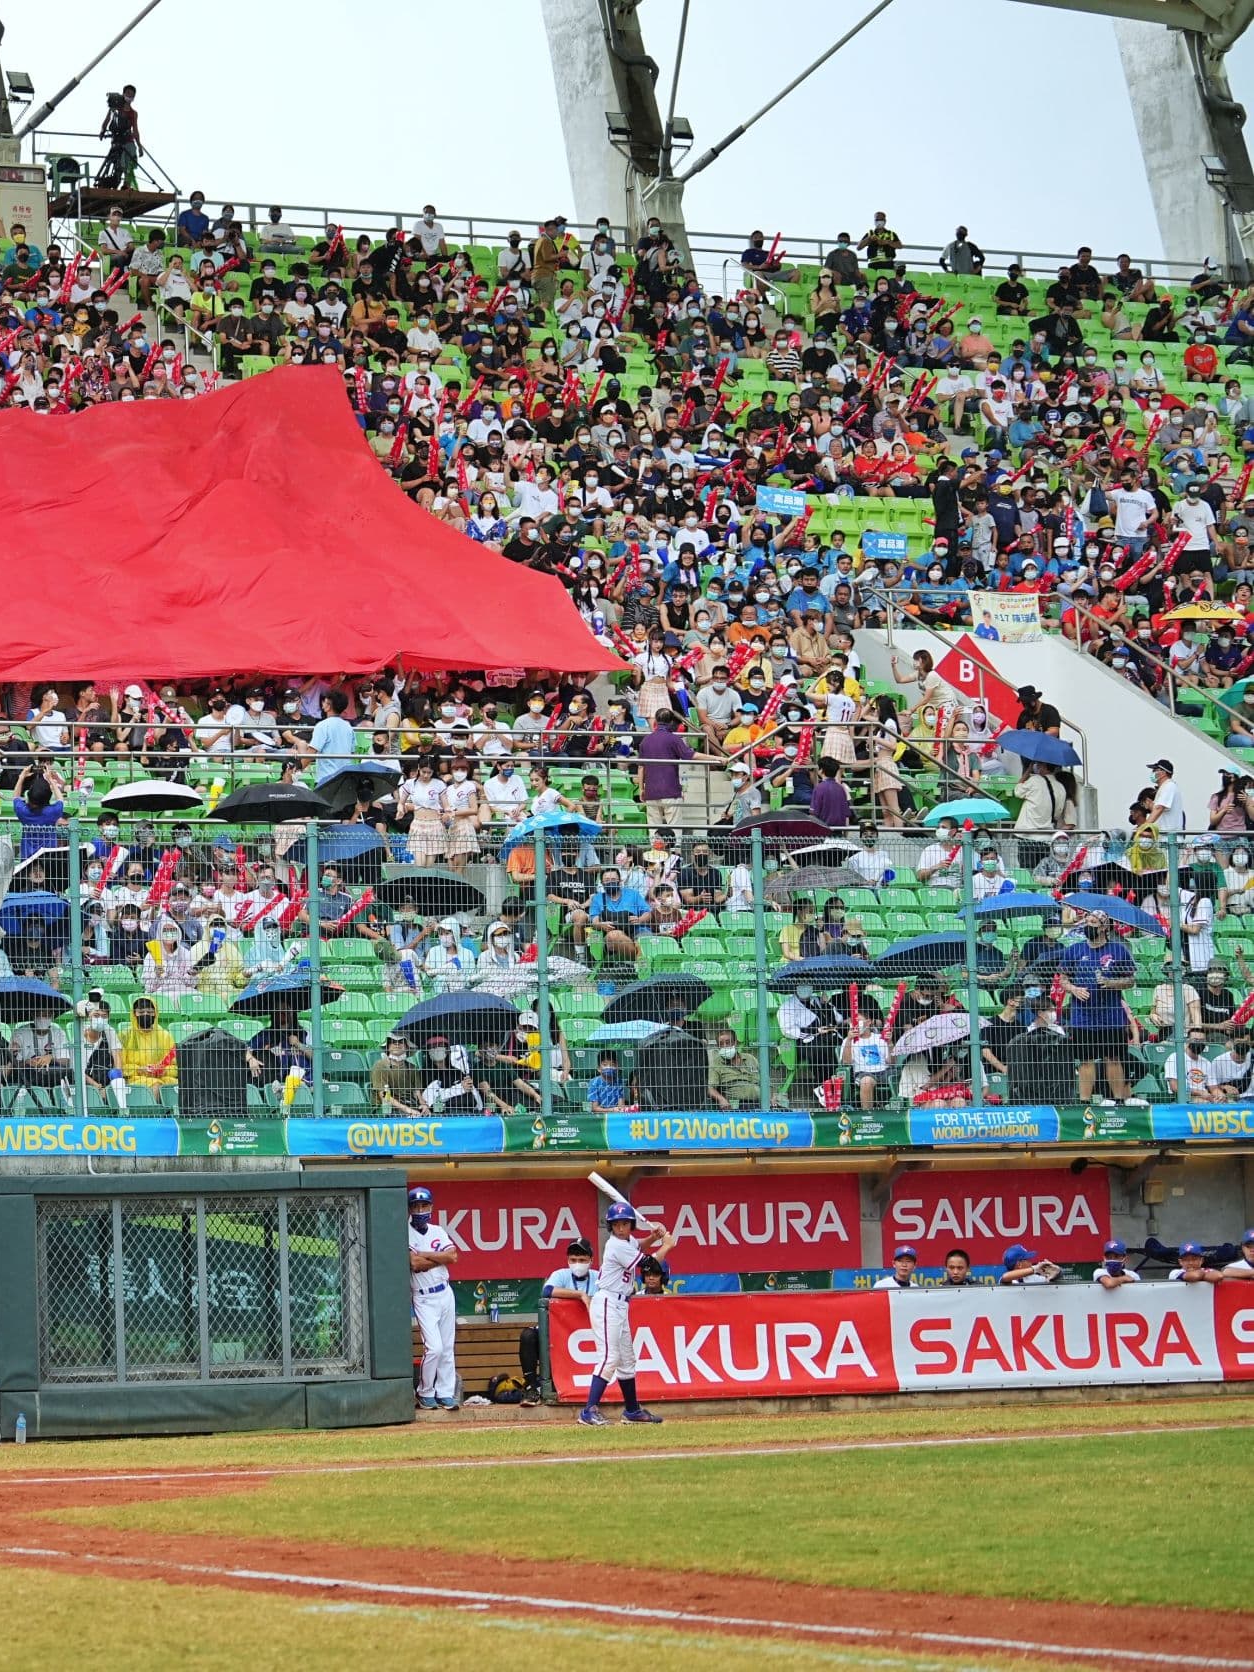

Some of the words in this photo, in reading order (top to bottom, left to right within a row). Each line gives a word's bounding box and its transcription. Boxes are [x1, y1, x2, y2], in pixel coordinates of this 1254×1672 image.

[959, 659, 975, 683] B
[629, 1118, 789, 1144] #U12WorldCup
[931, 1126, 976, 1140] WORLD
[978, 1124, 1039, 1138] CHAMPION
[935, 1113, 958, 1126] FOR
[960, 1112, 984, 1125] THE
[985, 1111, 1016, 1124] TITLE
[1016, 1110, 1032, 1123] OF
[347, 1122, 442, 1152] @WBSC
[438, 1206, 582, 1252] KURA
[635, 1200, 849, 1247] SAKURA
[892, 1195, 1099, 1241] SAKURA
[909, 1311, 1202, 1375] SAKURA
